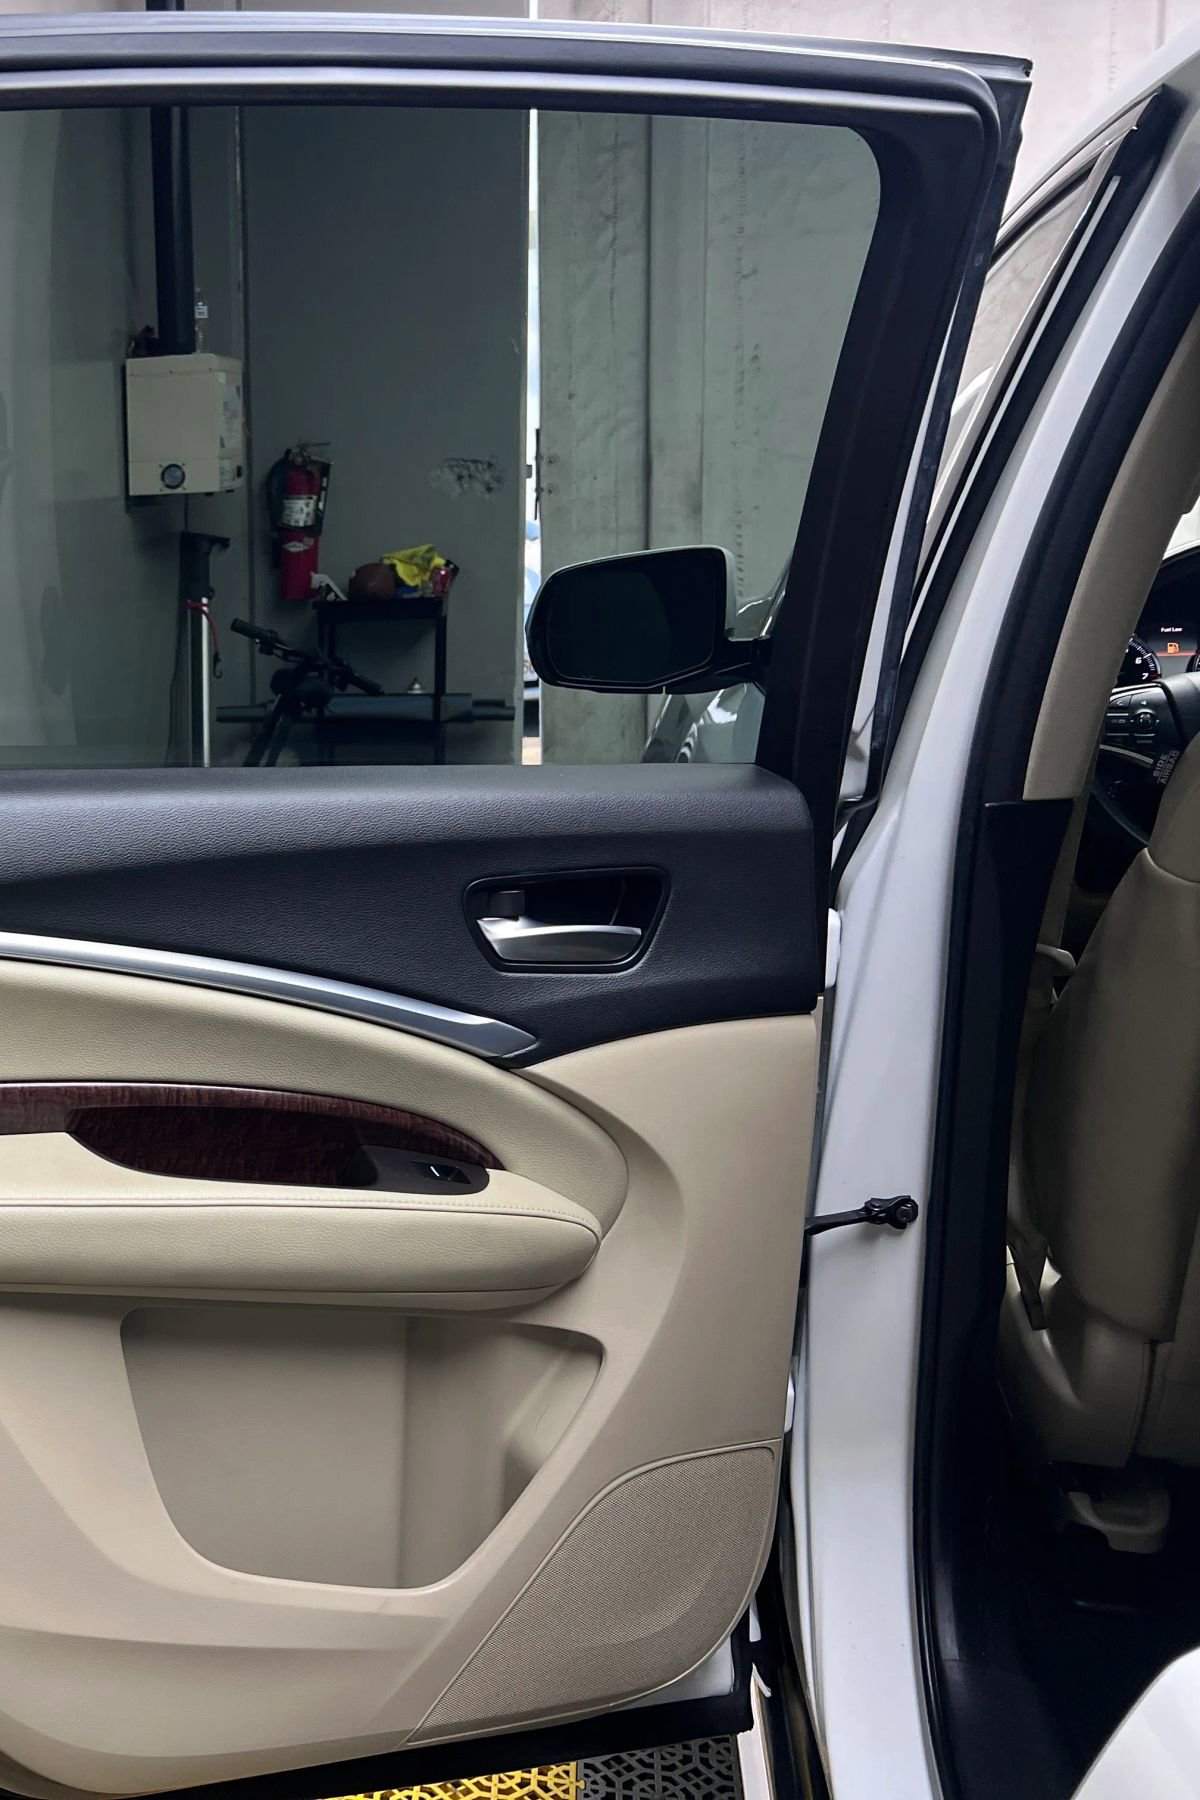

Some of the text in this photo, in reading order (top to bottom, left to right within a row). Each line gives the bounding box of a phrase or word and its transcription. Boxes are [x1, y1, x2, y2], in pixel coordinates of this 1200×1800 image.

[1142, 672, 1149, 680] 7
[1152, 752, 1168, 777] SIDE
[1160, 750, 1180, 785] AIRBAG
